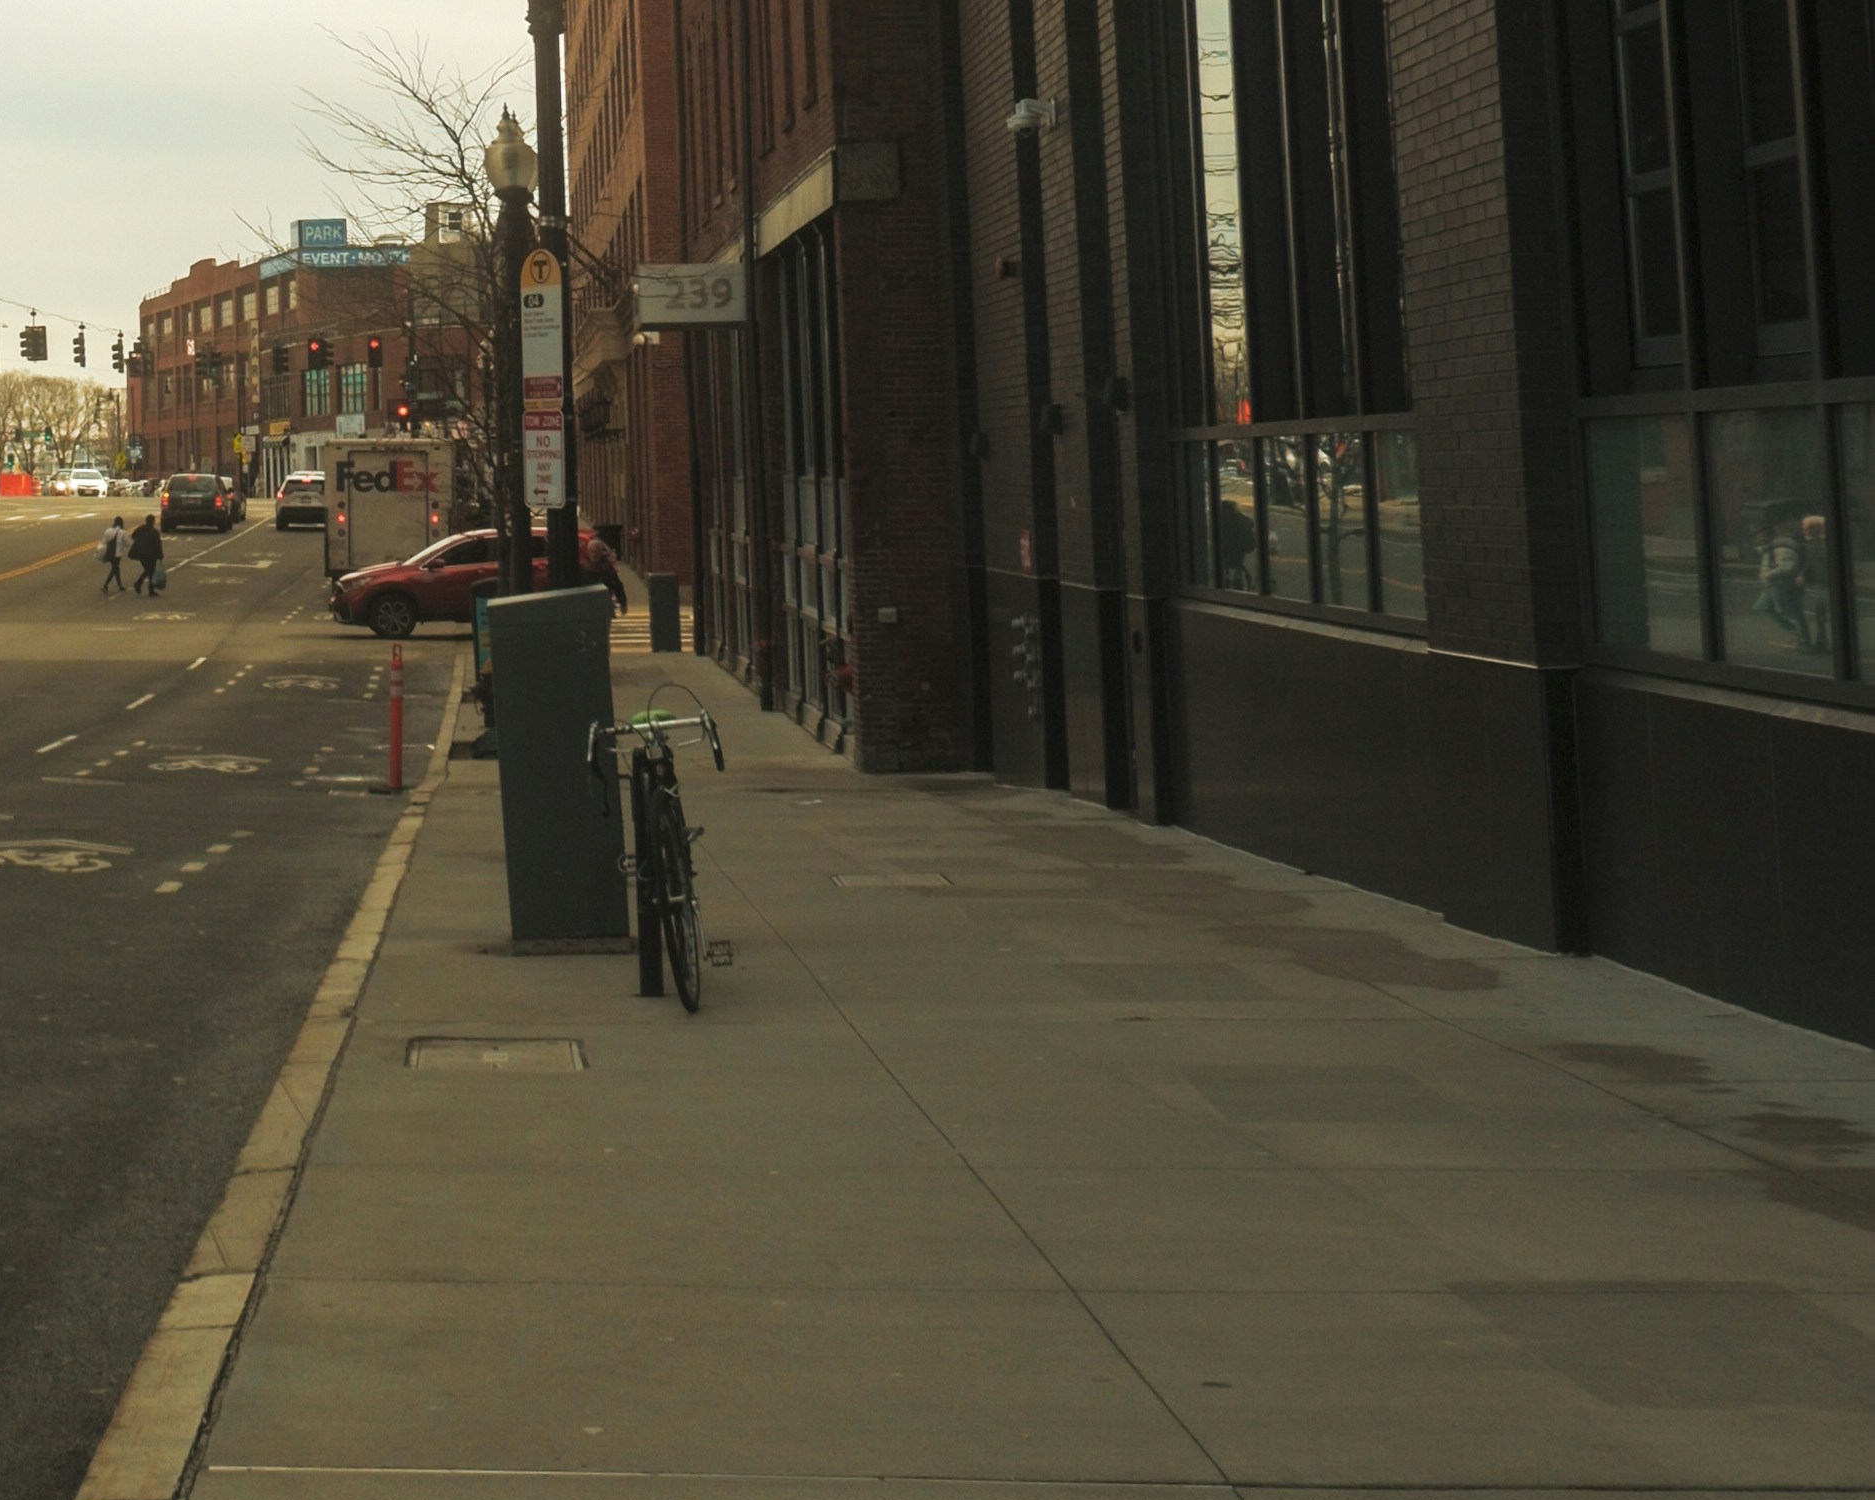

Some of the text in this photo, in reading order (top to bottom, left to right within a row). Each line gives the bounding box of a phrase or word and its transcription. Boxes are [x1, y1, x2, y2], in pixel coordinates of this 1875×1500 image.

[305, 225, 343, 242] PARK
[302, 251, 349, 265] EVENT
[665, 277, 733, 309] 239
[543, 414, 561, 427] ZONE
[536, 435, 551, 448] NO
[536, 462, 551, 472] ANY
[336, 461, 440, 493] FedEx
[536, 474, 553, 485] TIME
